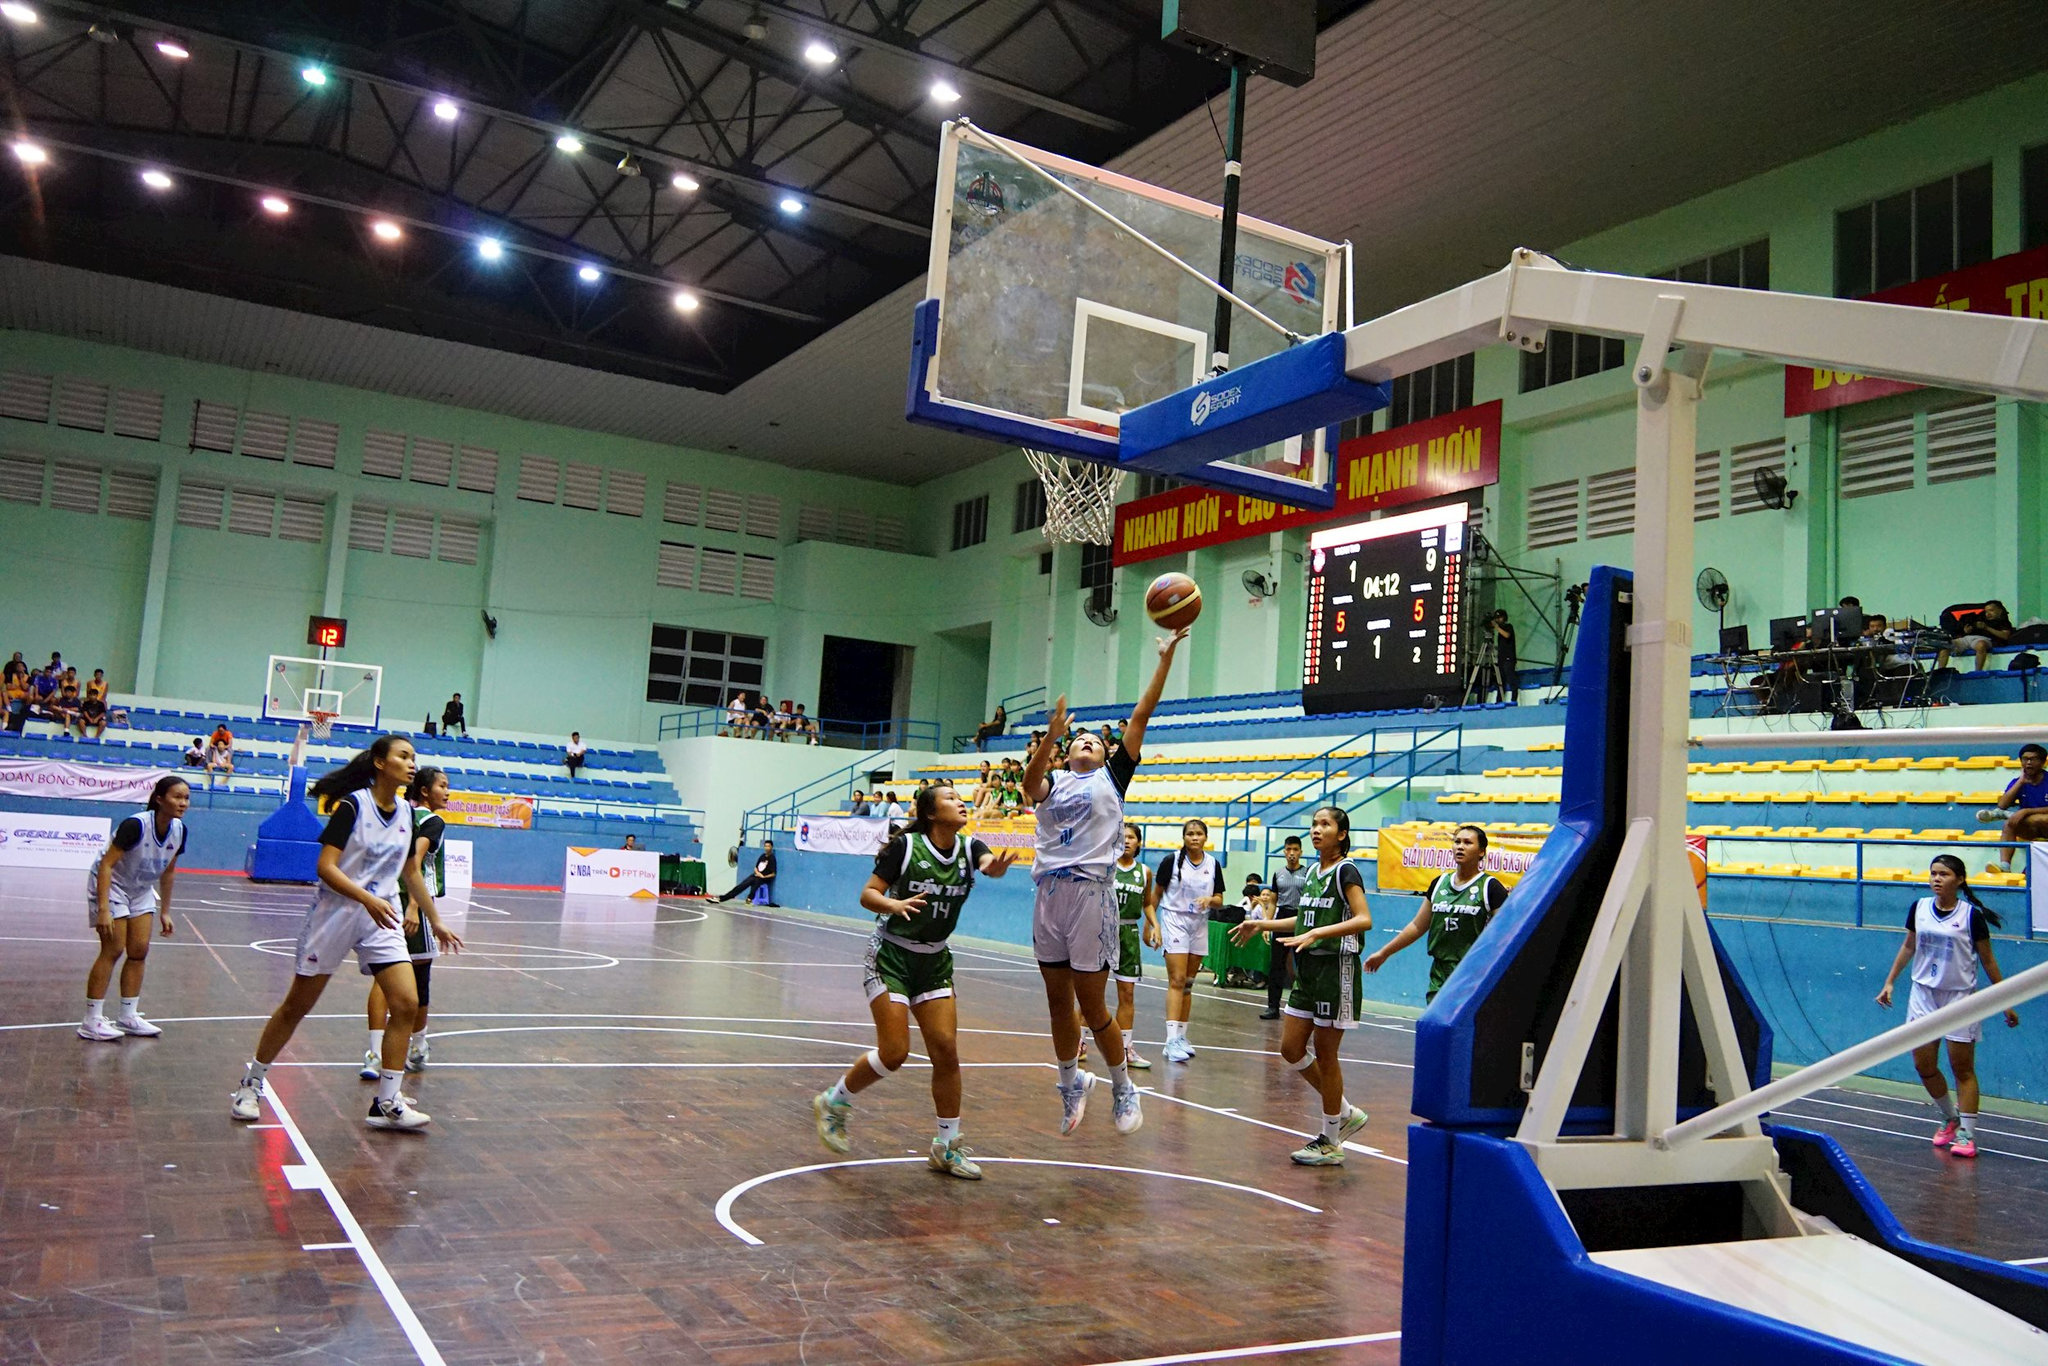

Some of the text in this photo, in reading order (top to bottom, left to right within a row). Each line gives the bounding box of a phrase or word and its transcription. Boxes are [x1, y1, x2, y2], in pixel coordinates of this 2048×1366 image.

[1210, 385, 1242, 403] SODEX
[1209, 394, 1241, 414] SPORT
[1123, 507, 1179, 553] NHANH
[1182, 493, 1220, 539] HƠN
[1237, 495, 1276, 526] CAO
[1348, 443, 1419, 503] MẠNH
[1426, 424, 1482, 482] HƠN
[1349, 548, 1436, 583] 1 9
[1363, 573, 1400, 599] 04:12
[1336, 610, 1346, 633] 5
[1413, 598, 1425, 622] 5
[321, 629, 338, 645] 12
[1373, 634, 1381, 660] 1
[1335, 646, 1421, 672] 1 2
[577, 865, 591, 877] NBA
[622, 869, 656, 880] FPT Play
[909, 878, 943, 895] CẦN
[1119, 892, 1128, 904] 11
[931, 901, 950, 919] 14
[1303, 910, 1315, 927] 10
[1444, 917, 1459, 932] 15
[1931, 963, 1938, 977] 8
[1315, 1001, 1331, 1016] 10
